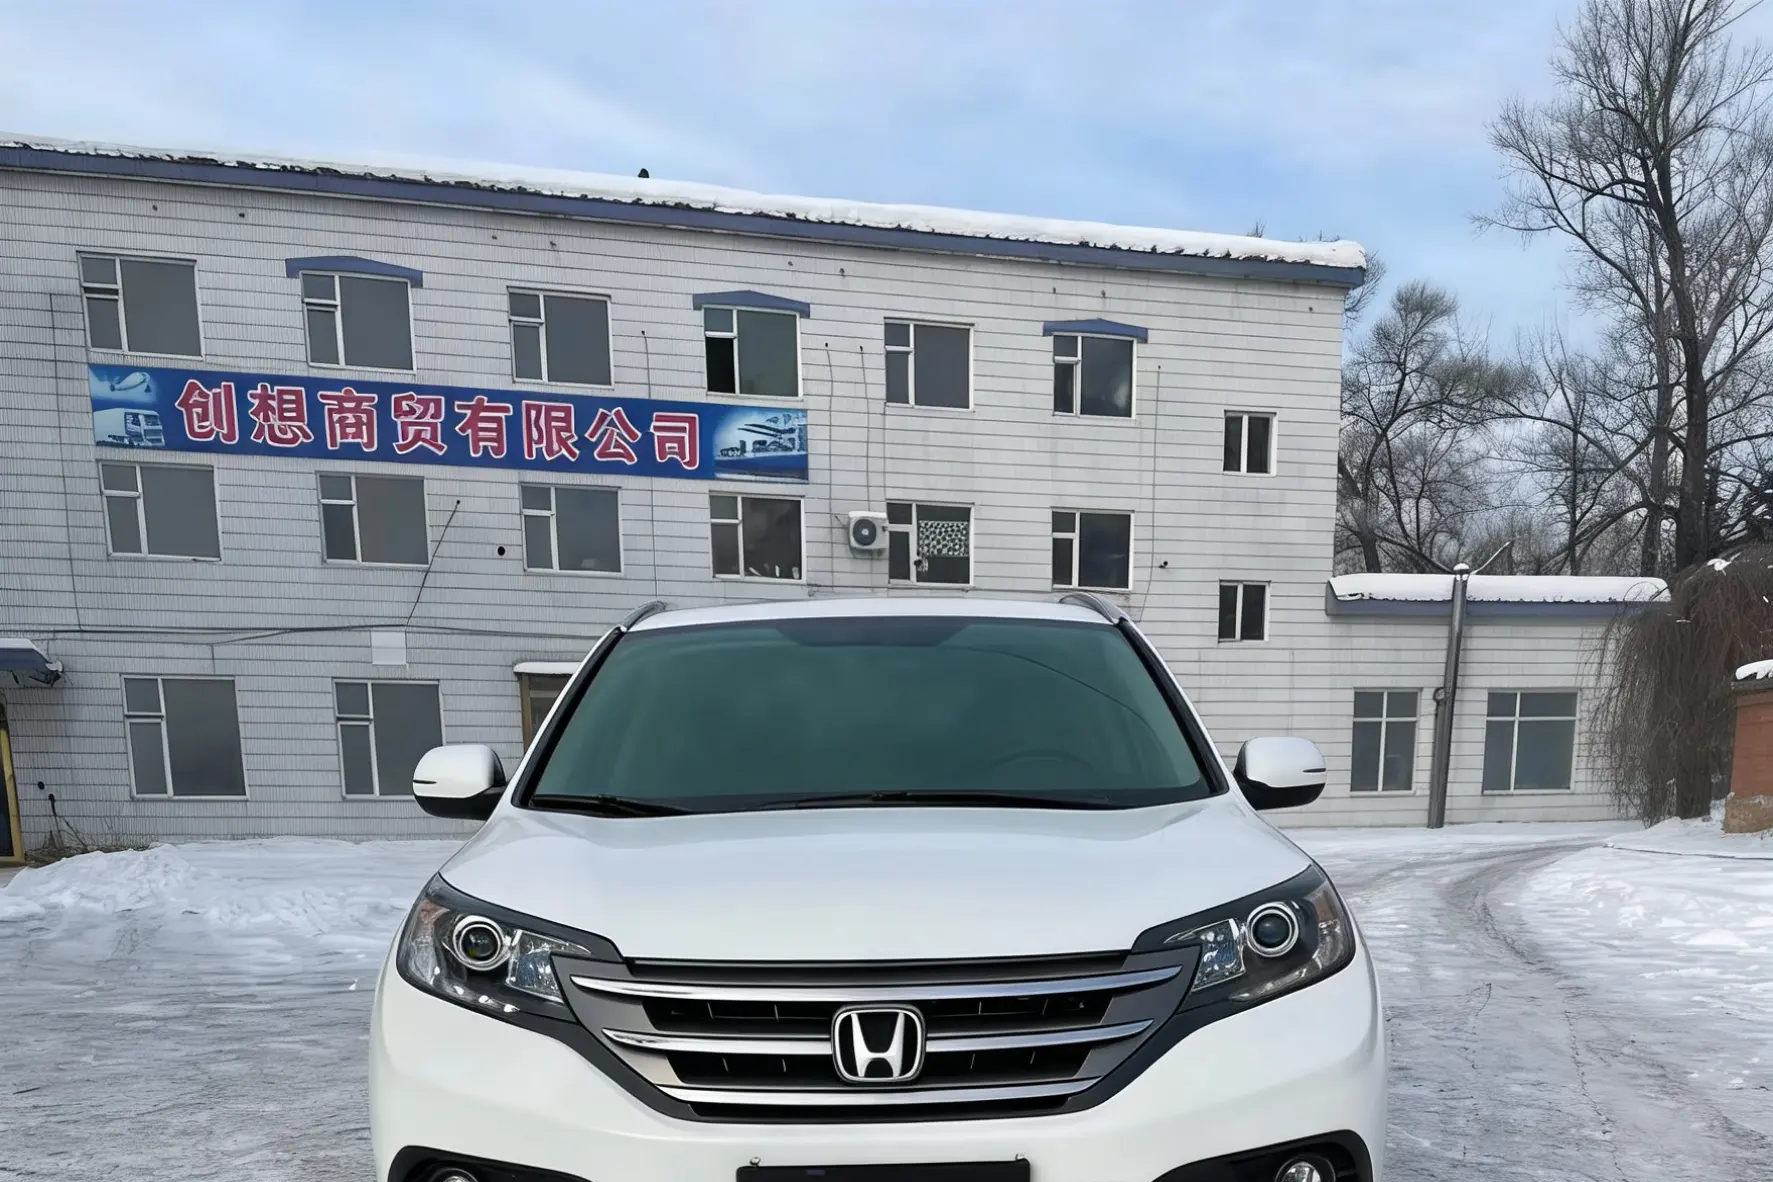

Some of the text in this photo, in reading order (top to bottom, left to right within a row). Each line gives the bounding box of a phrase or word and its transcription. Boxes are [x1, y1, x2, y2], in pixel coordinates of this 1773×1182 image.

[175, 379, 700, 470] 创想商贸有限公司
